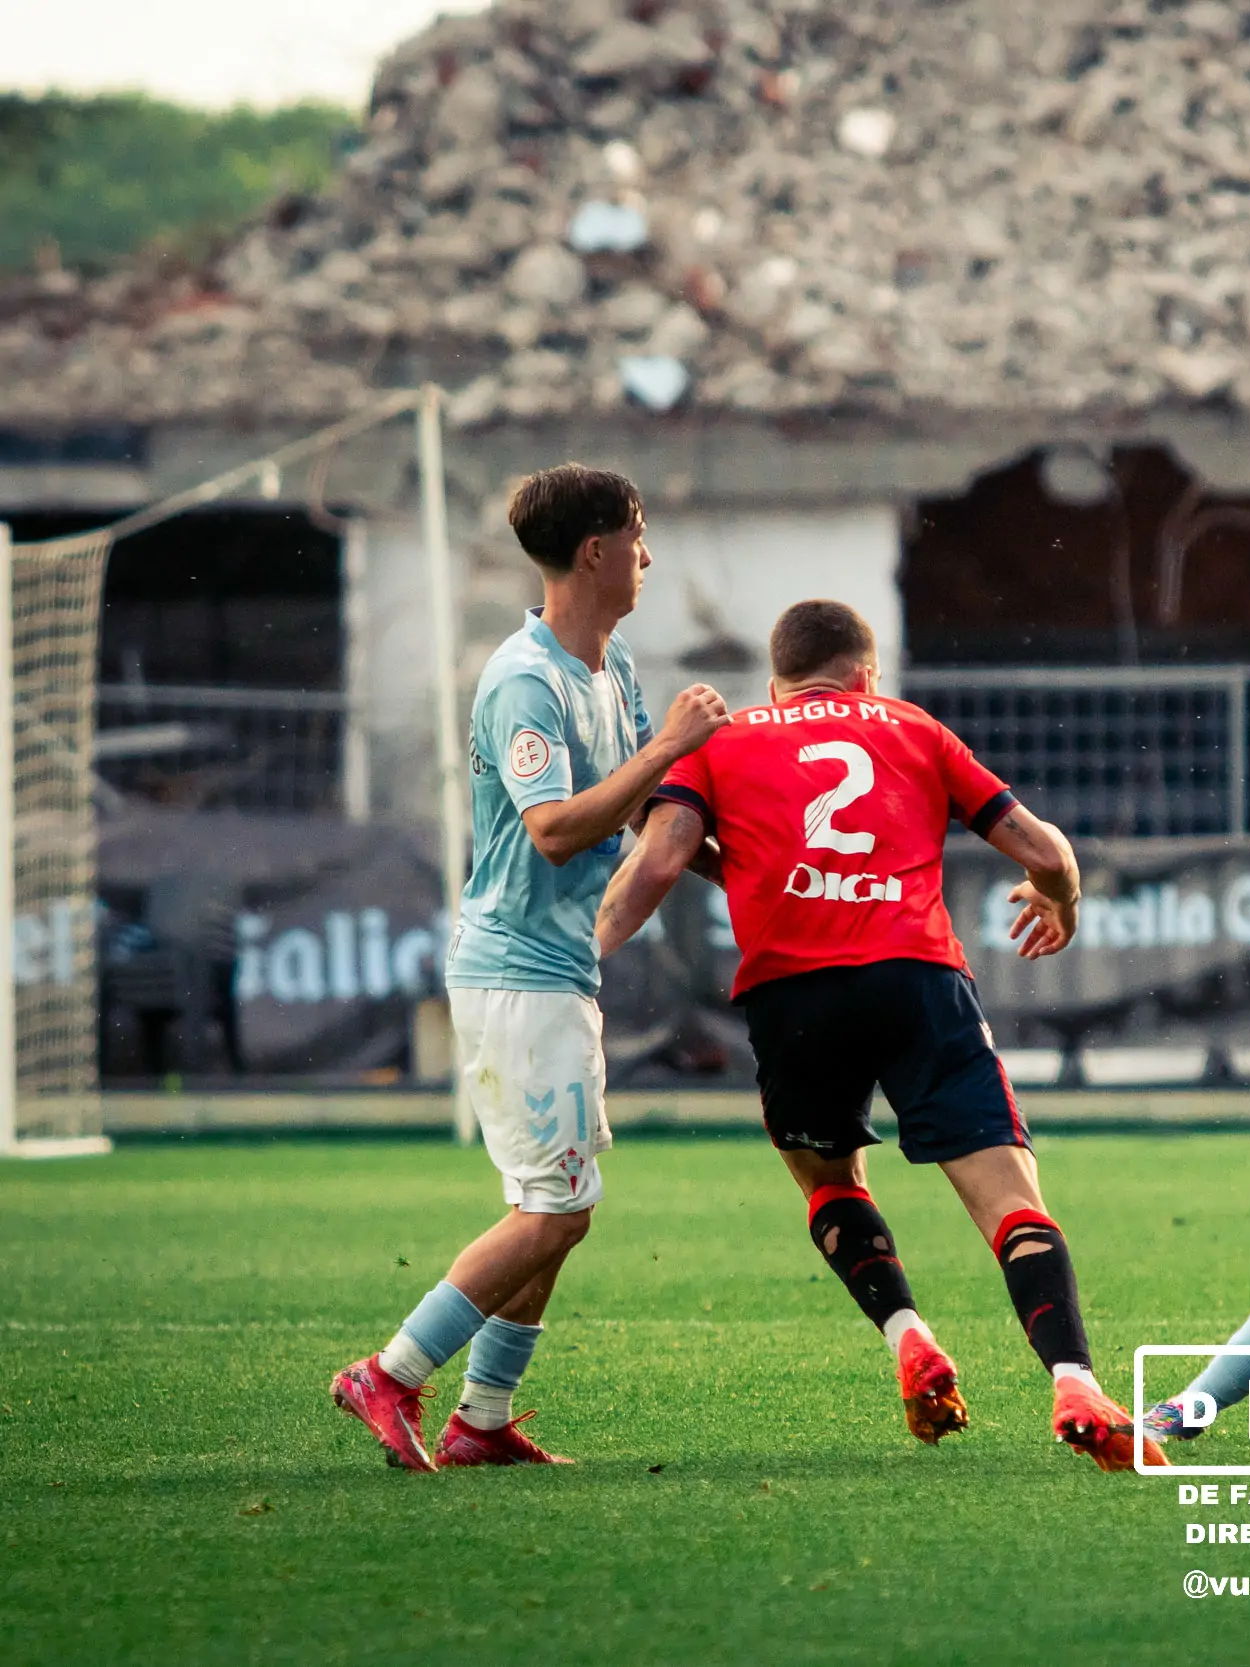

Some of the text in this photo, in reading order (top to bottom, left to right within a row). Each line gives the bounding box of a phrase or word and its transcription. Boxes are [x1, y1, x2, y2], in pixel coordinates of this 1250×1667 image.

[748, 701, 900, 725] DIEGO M.
[798, 741, 876, 855] 2
[783, 862, 903, 903] DIGI
